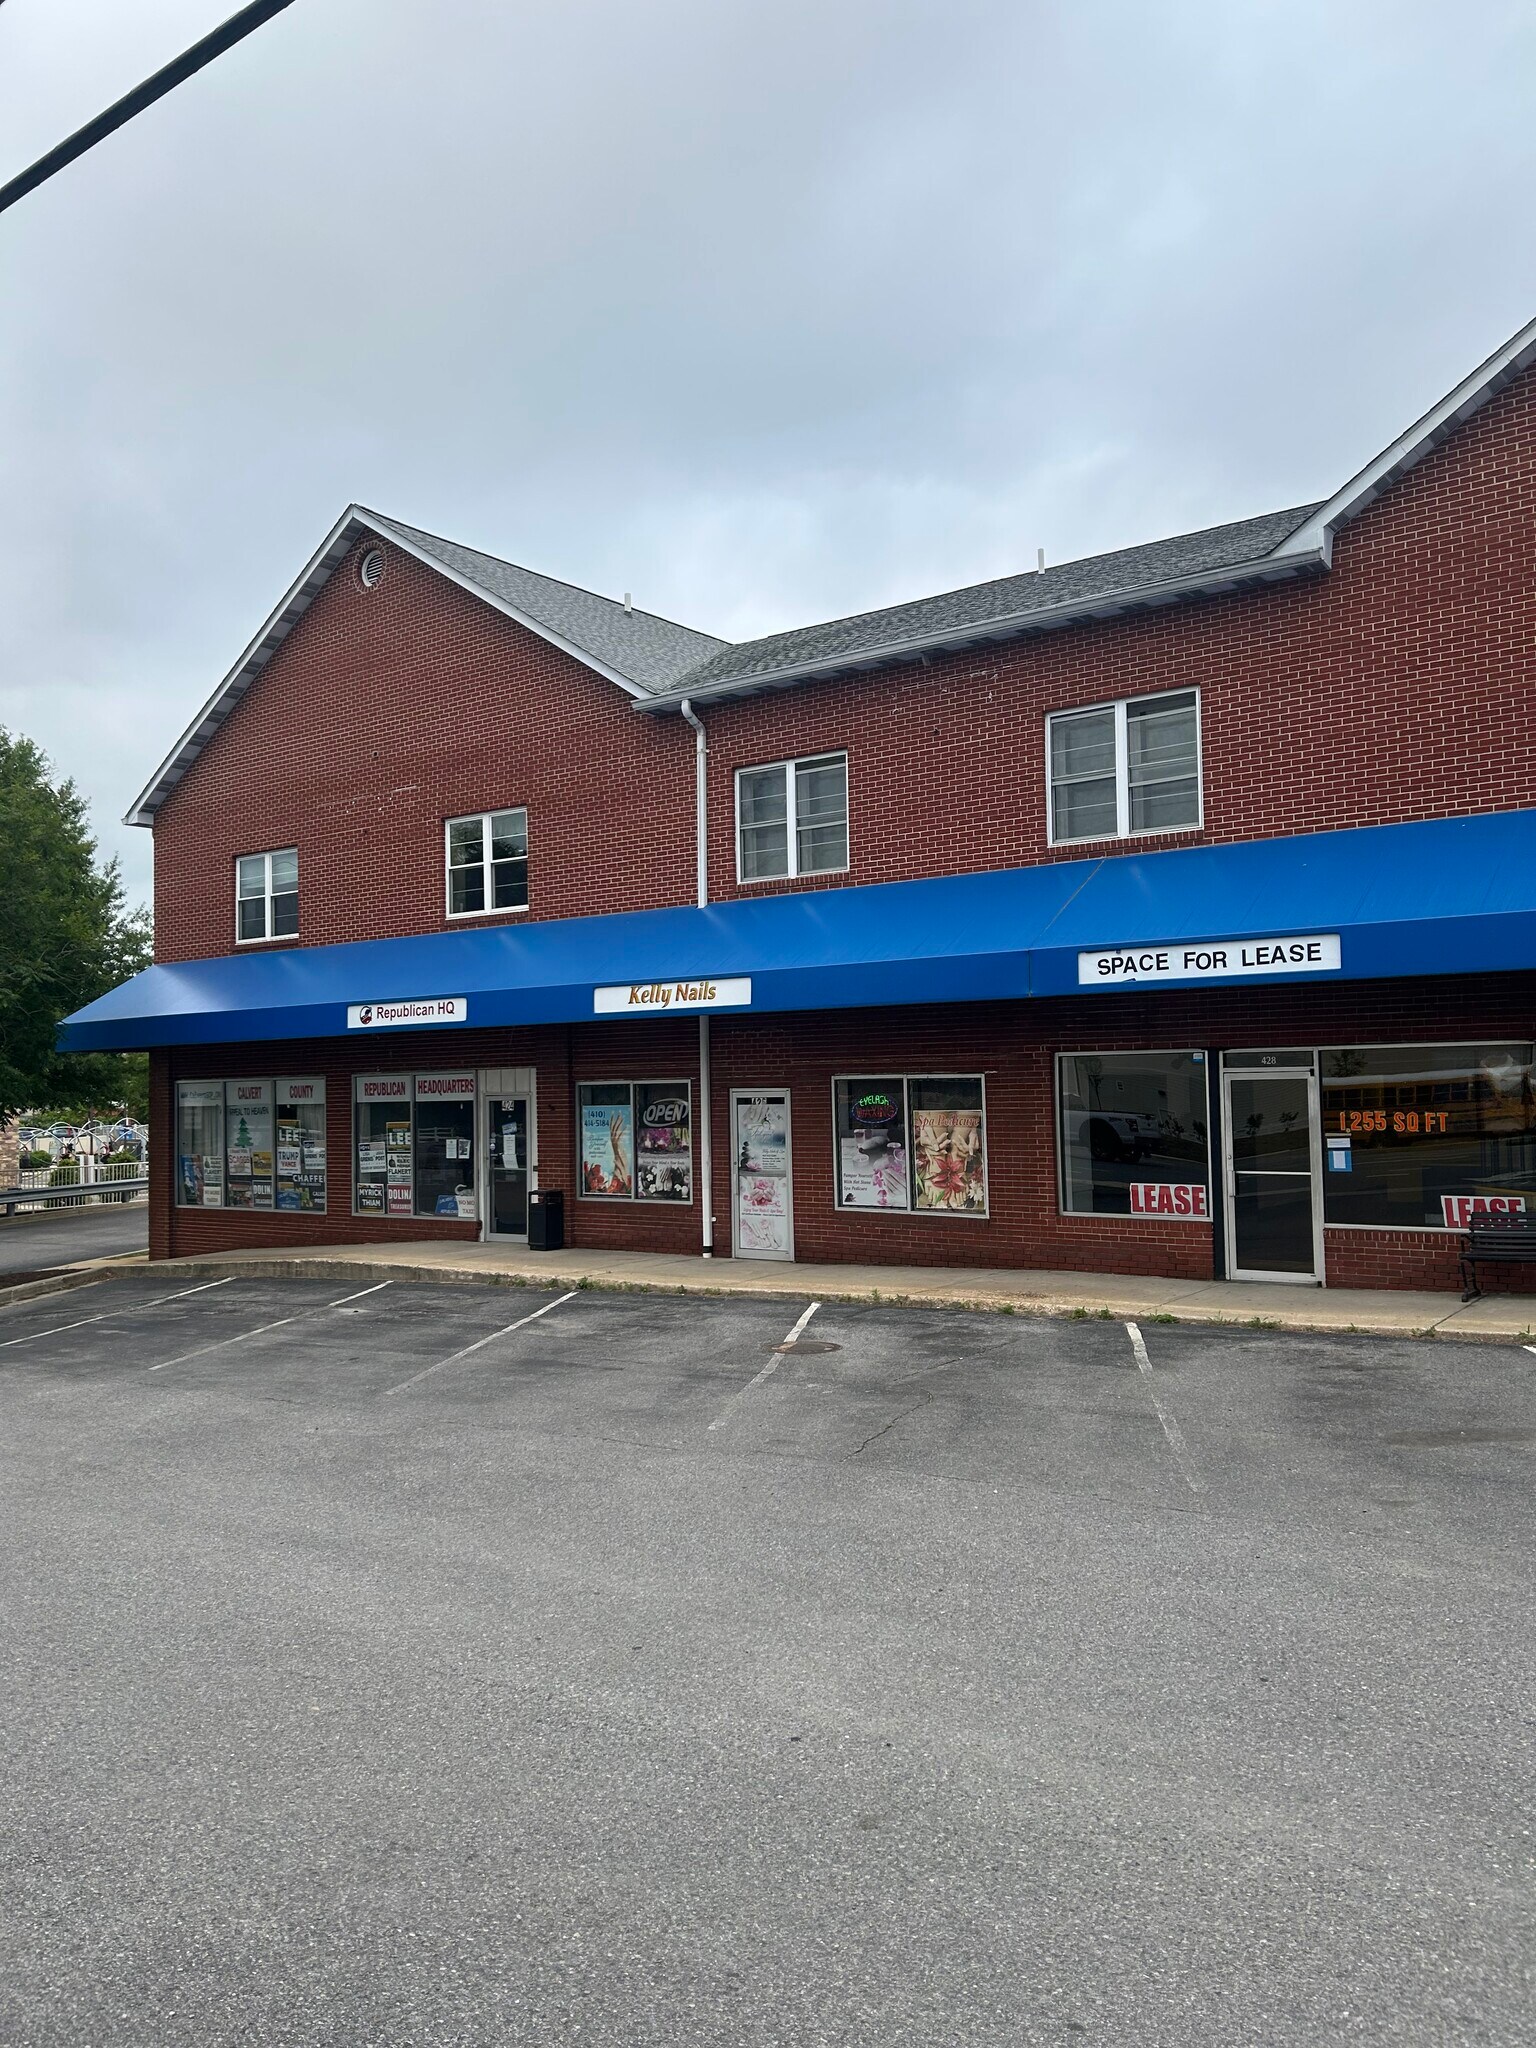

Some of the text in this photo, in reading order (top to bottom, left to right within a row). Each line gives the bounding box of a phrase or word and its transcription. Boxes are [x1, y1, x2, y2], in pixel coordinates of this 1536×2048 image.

[1097, 943, 1323, 976] SPACE FOR LEASE
[628, 981, 716, 1008] Kelly Nails
[376, 1001, 455, 1021] Republican HQ
[1261, 1056, 1277, 1065] 428
[237, 1085, 314, 1099] CALVERT COUNTY
[364, 1079, 474, 1096] REPUBLICAN HEADQUARTERS
[502, 1101, 515, 1110] 424
[859, 1095, 890, 1107] EYELASH
[646, 1104, 683, 1121] OPEN
[917, 1113, 980, 1129] Spa Pedicure
[1394, 1111, 1419, 1132] SQ
[1424, 1112, 1449, 1133] FT
[278, 1129, 300, 1142] LEE
[389, 1132, 411, 1145] LEE
[278, 1151, 299, 1160] TRUMP
[1131, 1185, 1205, 1215] LEASE
[1445, 1198, 1522, 1229] LEASE
